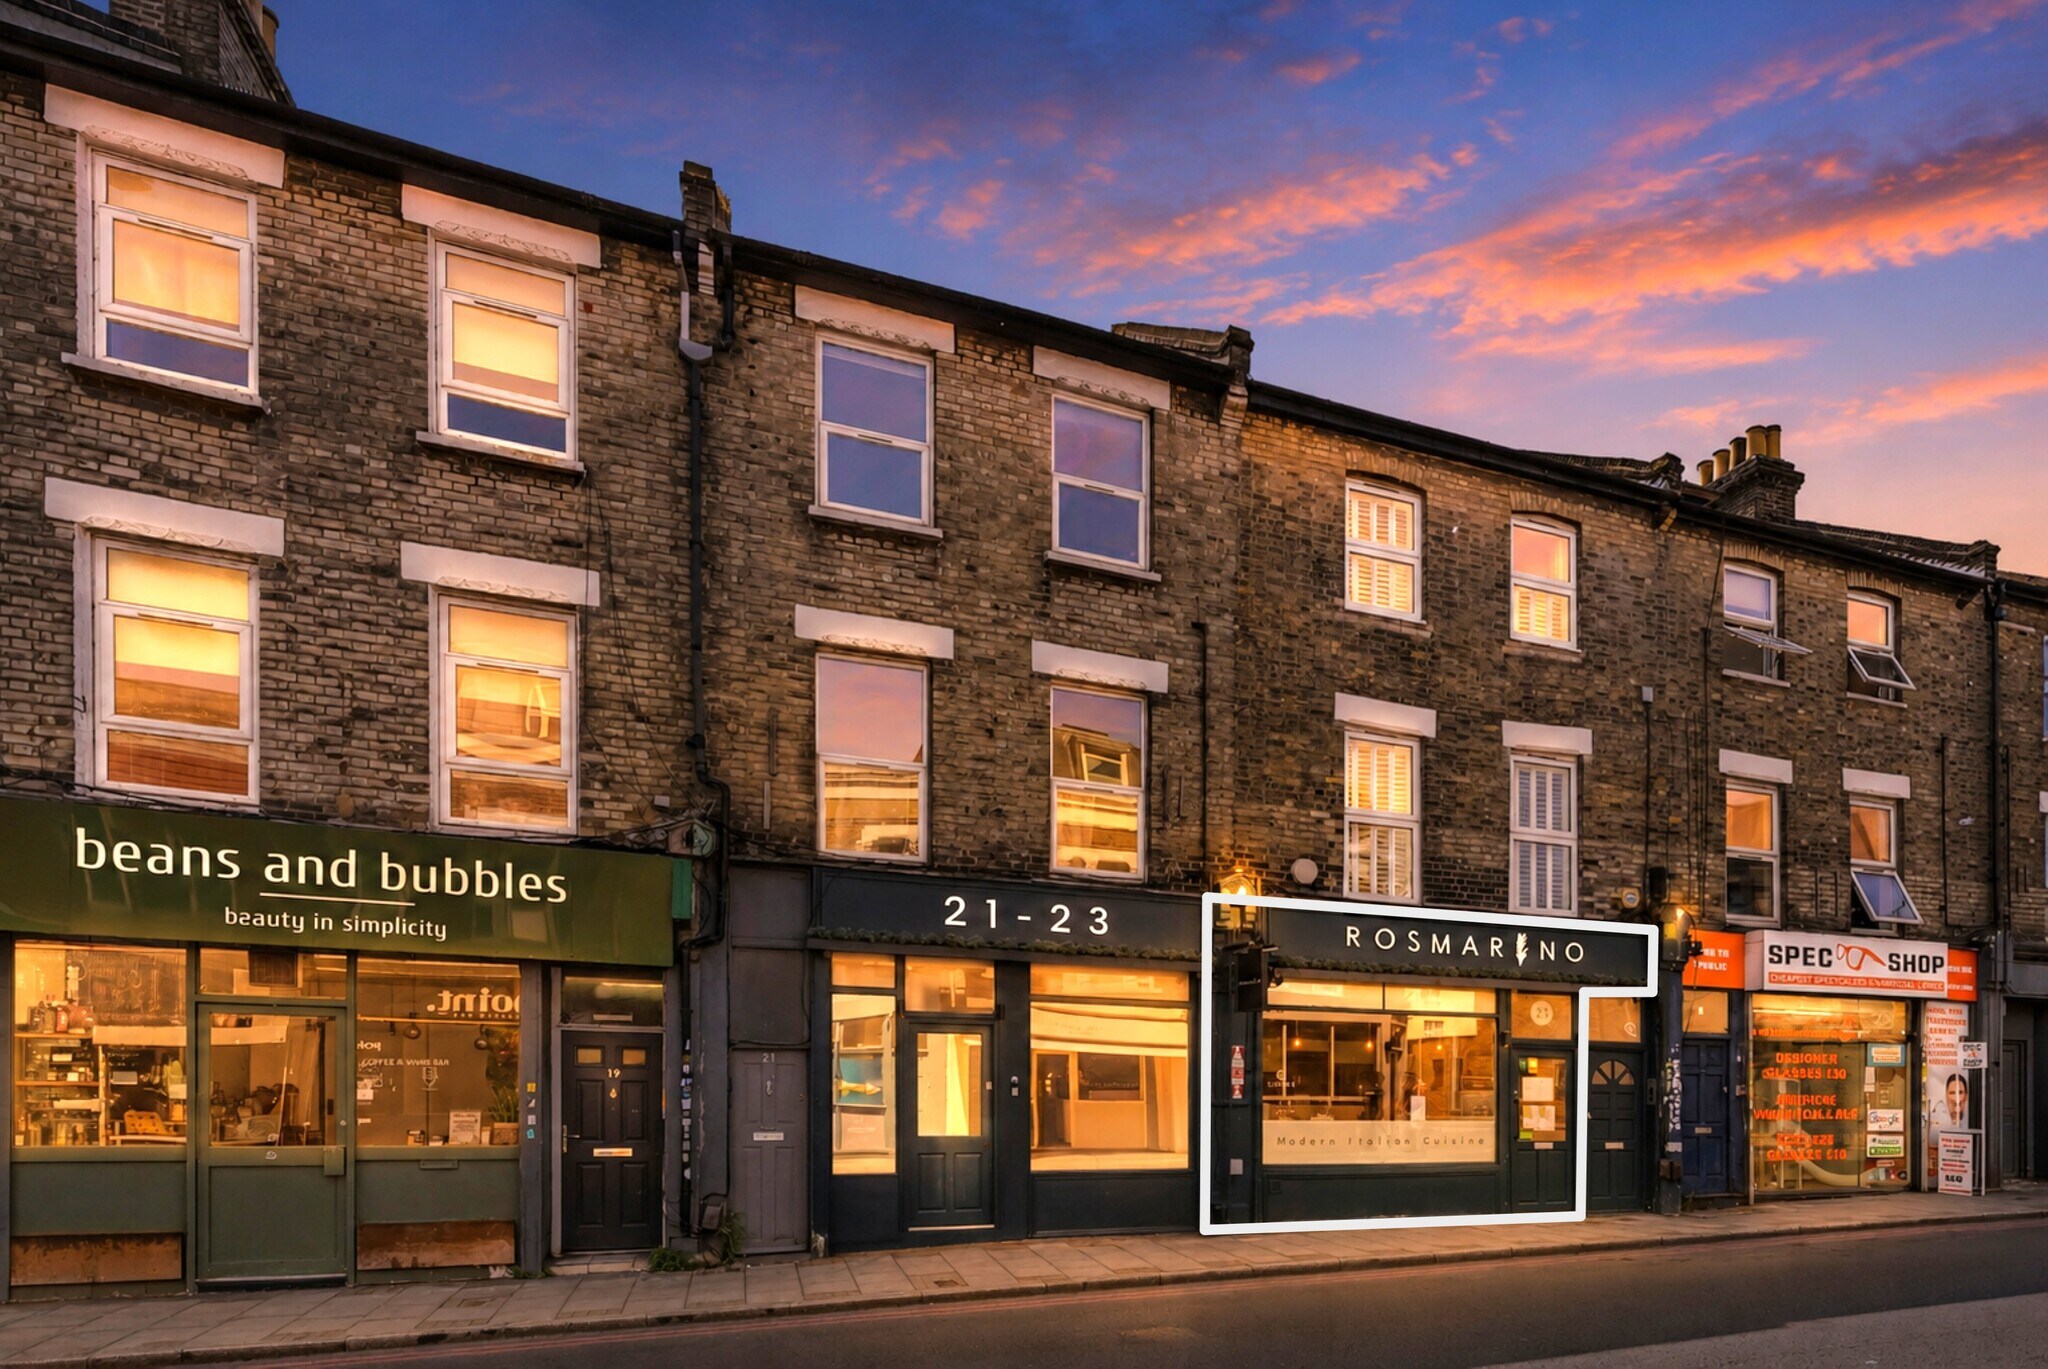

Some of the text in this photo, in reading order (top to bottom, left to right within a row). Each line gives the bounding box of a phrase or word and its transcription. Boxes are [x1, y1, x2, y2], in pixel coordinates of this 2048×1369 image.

[76, 827, 567, 903] beans and bubbles
[224, 906, 447, 942] beauty in simplicity
[1768, 943, 1945, 976] SPEC SHOP
[762, 1053, 775, 1063] 21
[607, 1068, 621, 1079] 19
[1277, 1136, 1485, 1147] Modern Italian Cuisine
